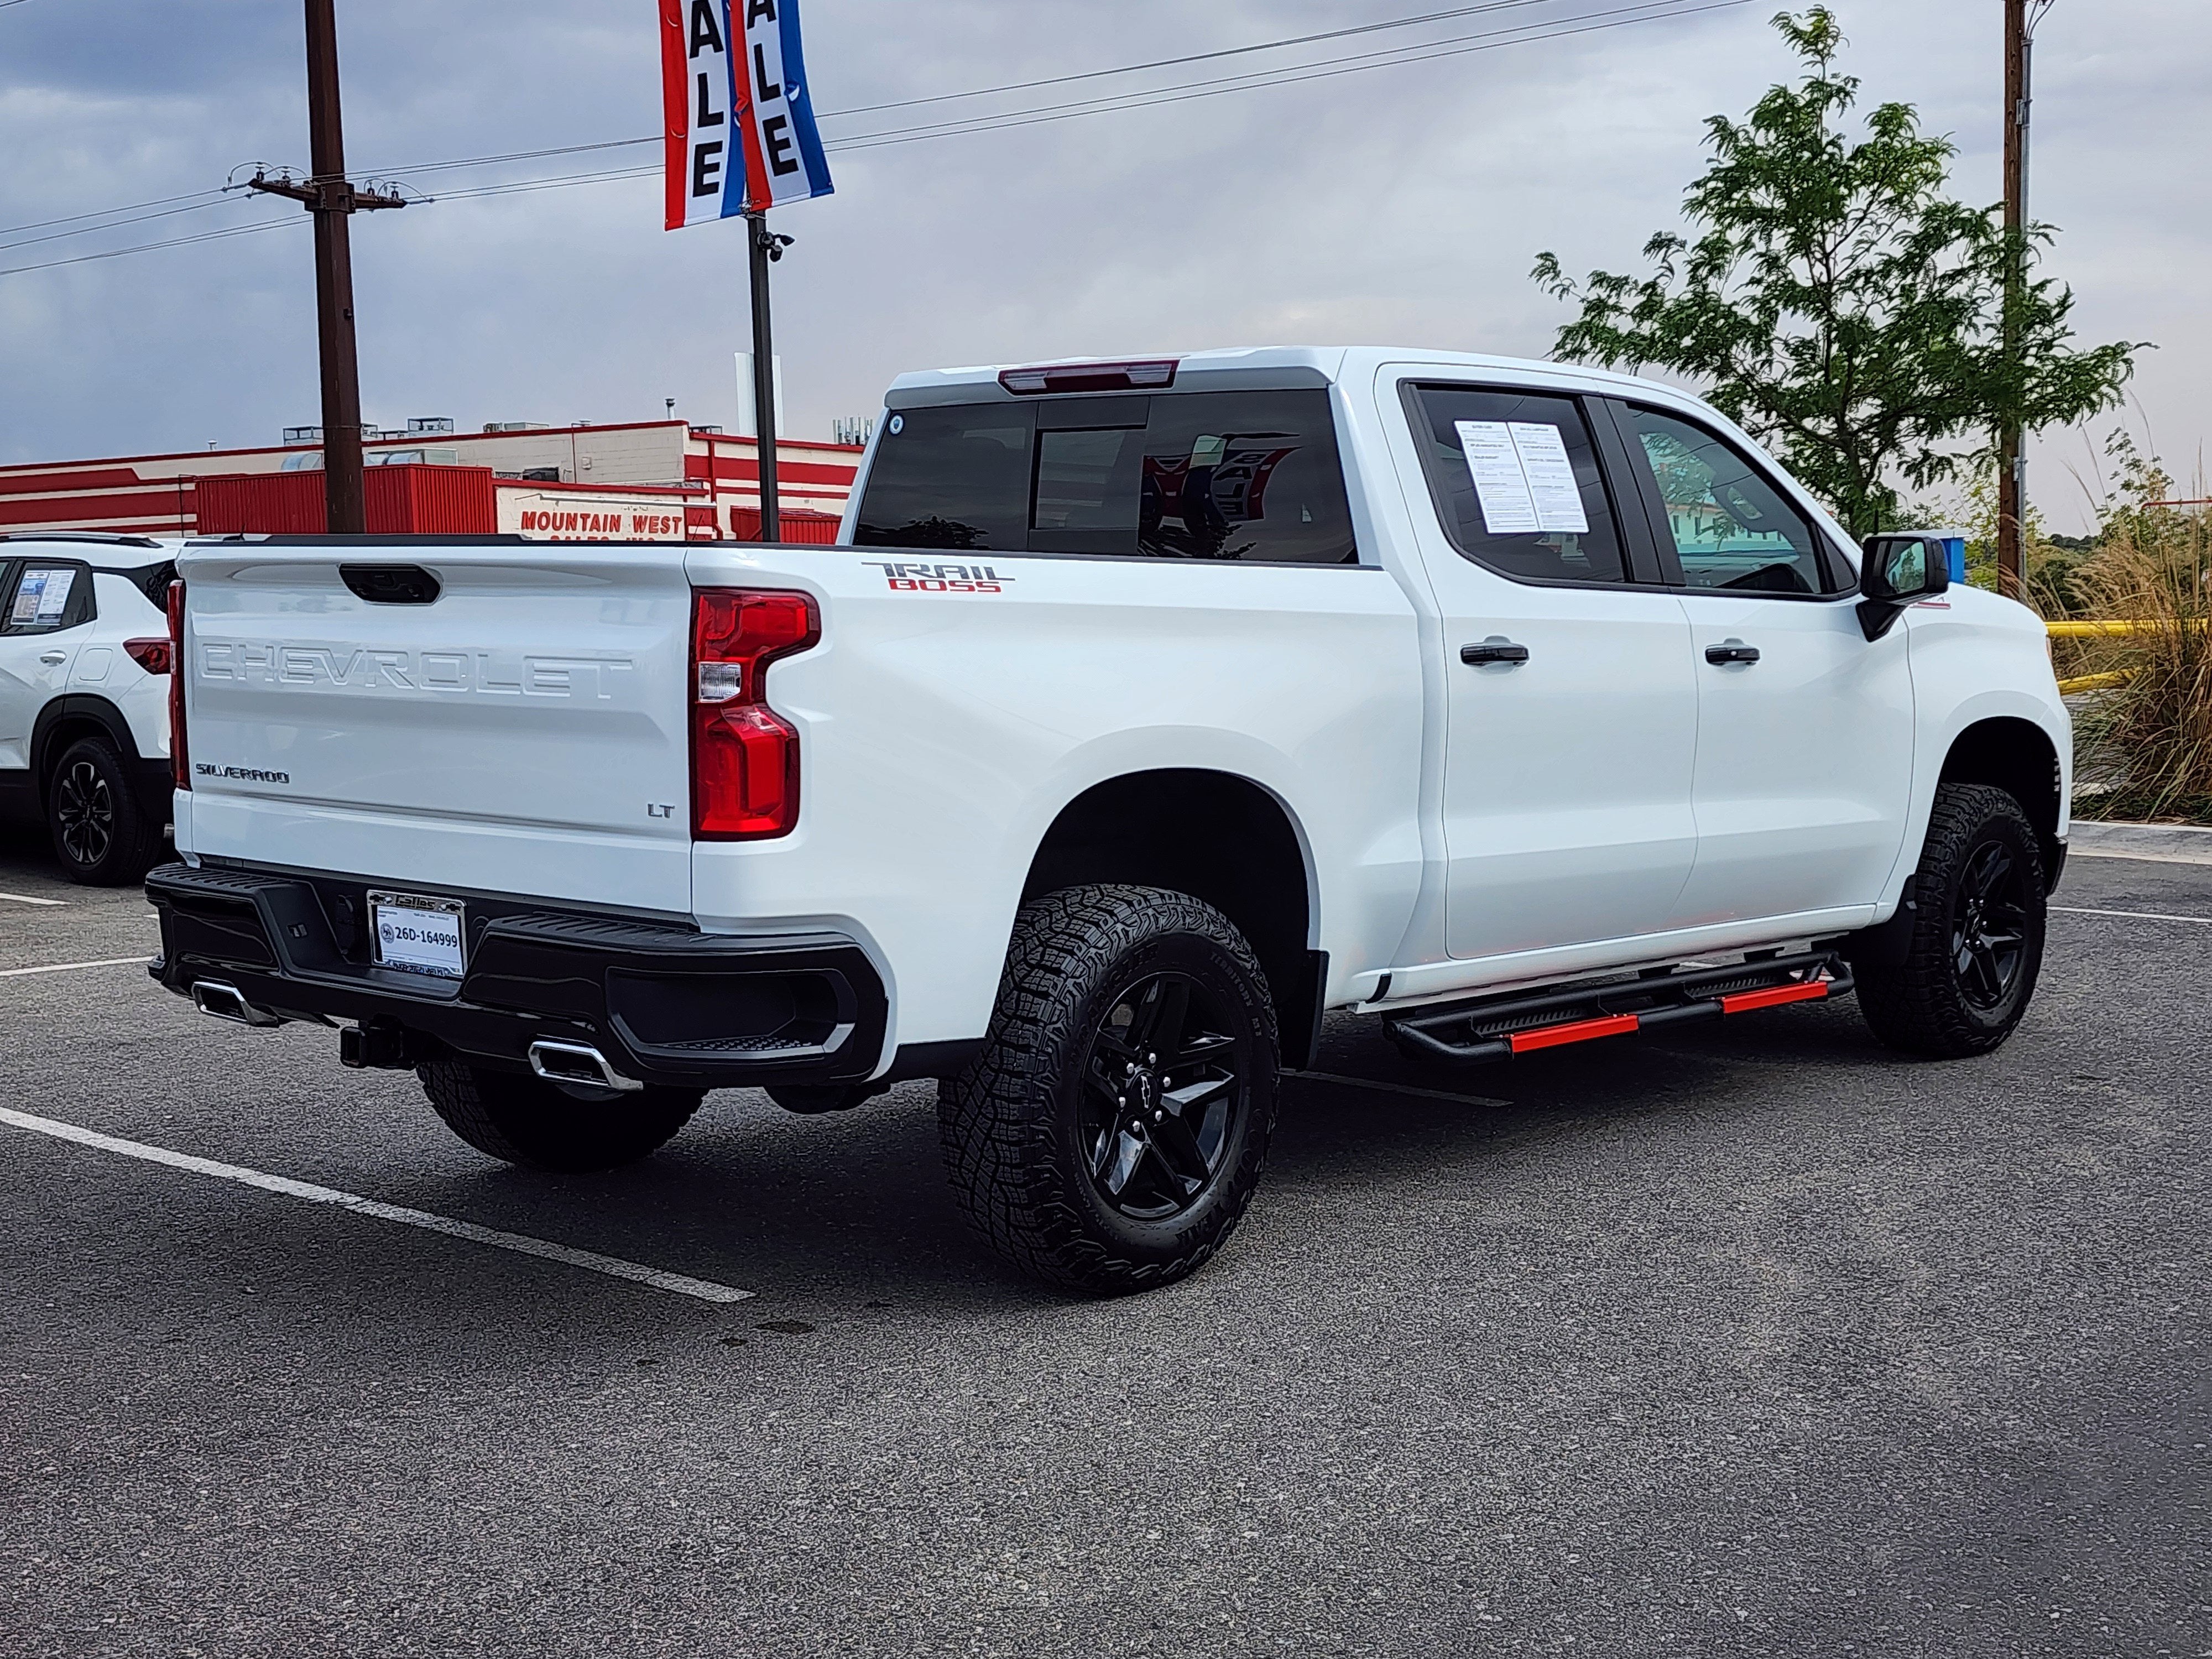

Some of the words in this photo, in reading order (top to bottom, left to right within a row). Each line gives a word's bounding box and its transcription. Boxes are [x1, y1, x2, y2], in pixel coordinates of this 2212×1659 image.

[520, 510, 622, 533] MOUNTAIN
[632, 514, 683, 534] WEST
[860, 561, 1016, 581] TRAIL
[887, 578, 1001, 593] BOSS
[201, 643, 634, 700] CHEVROLET
[195, 763, 290, 784] SILVERADO
[647, 803, 676, 818] LT
[394, 926, 458, 948] 26D-164999
